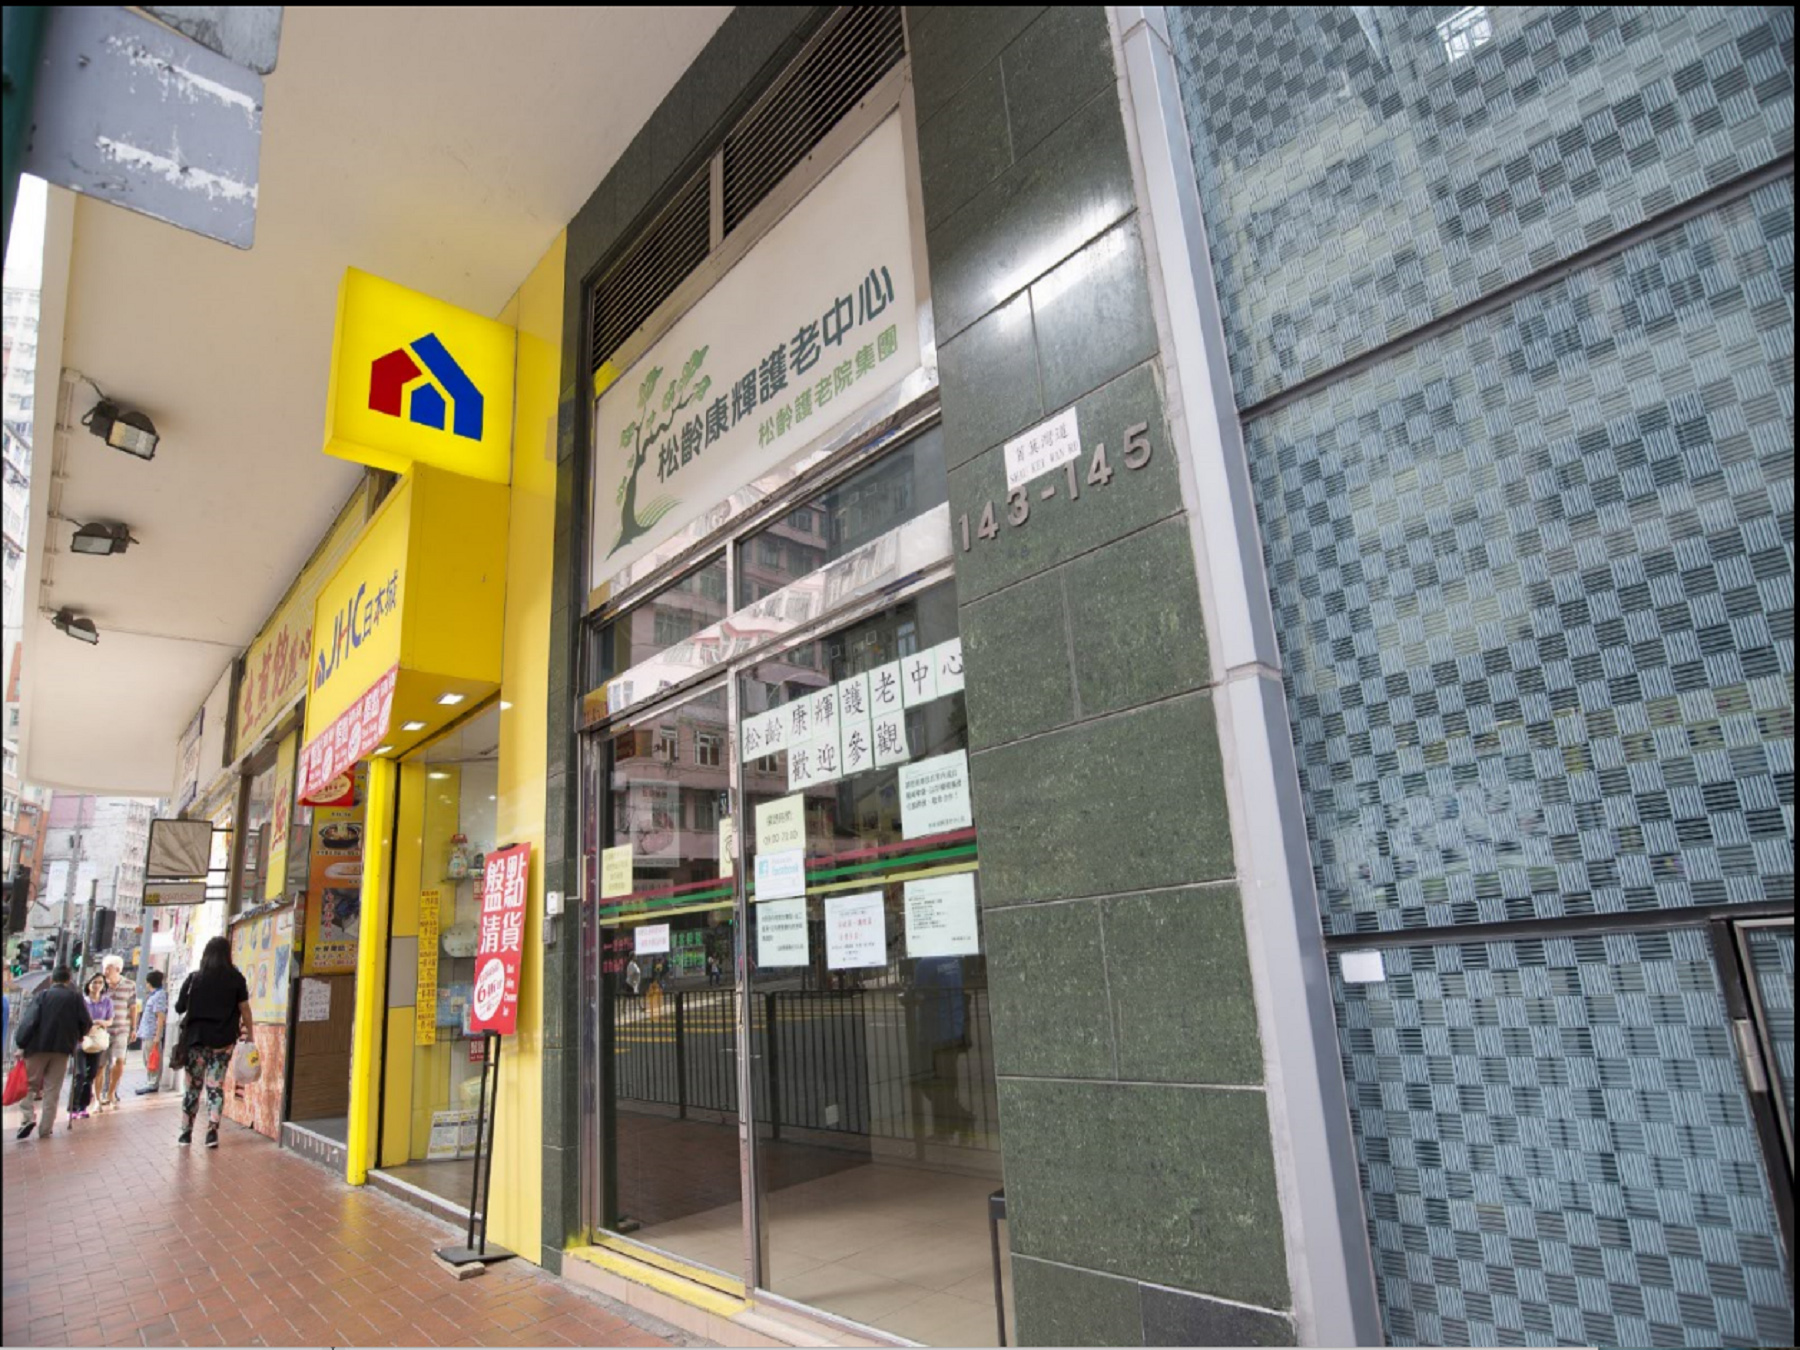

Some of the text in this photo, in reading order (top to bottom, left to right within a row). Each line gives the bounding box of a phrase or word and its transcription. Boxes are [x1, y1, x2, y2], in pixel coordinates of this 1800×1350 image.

[657, 265, 895, 483] 松齡康輝護老中心
[758, 324, 898, 449] 松齡護老院集團
[958, 421, 1153, 552] 143-145
[326, 580, 367, 680] JHC
[744, 656, 963, 754] 松齡康輝護老中心
[791, 724, 903, 783] 歡迎參觀
[484, 852, 527, 912] 盤點
[480, 911, 522, 955] 清貨
